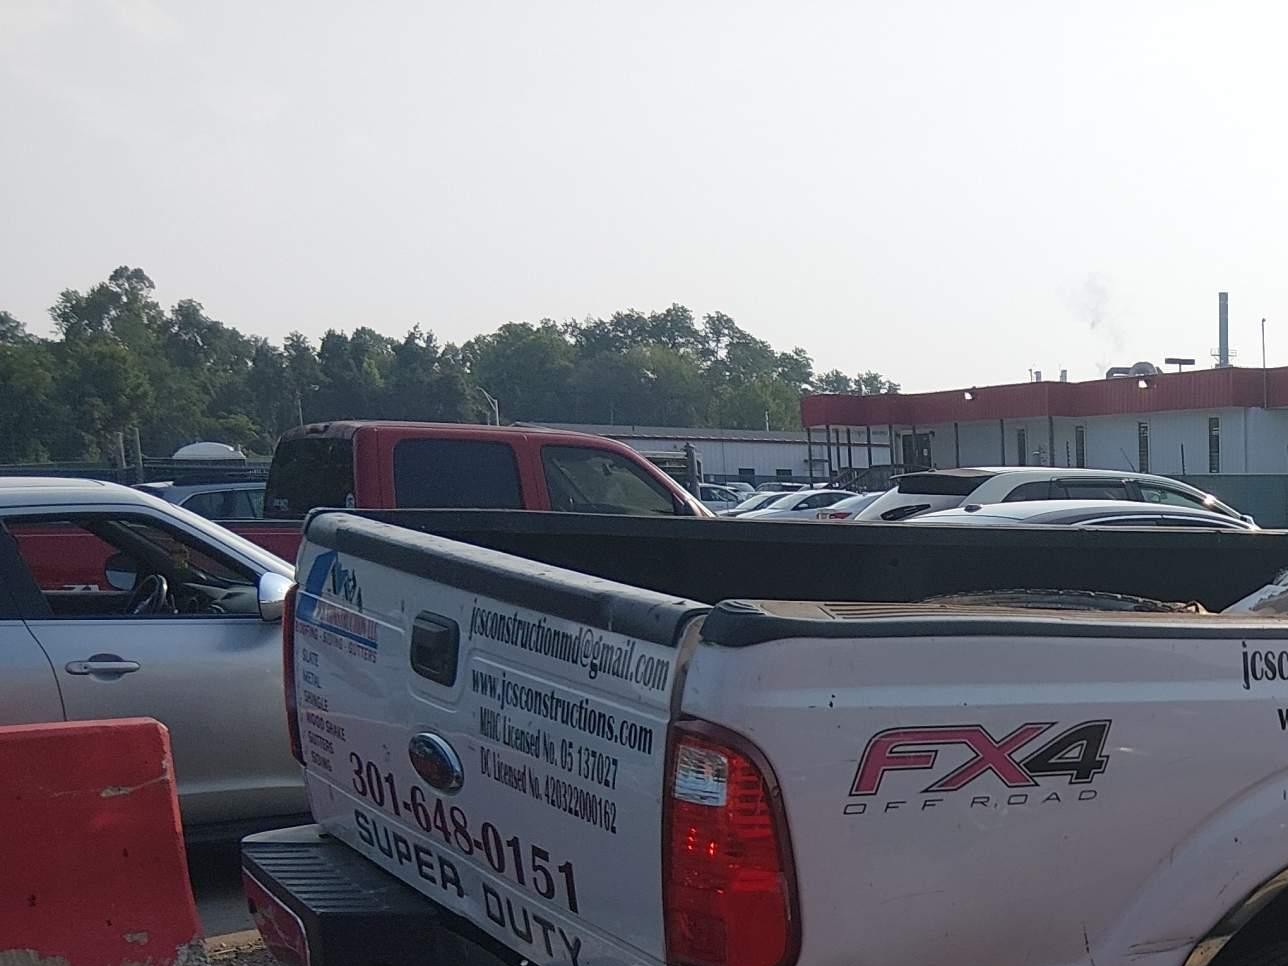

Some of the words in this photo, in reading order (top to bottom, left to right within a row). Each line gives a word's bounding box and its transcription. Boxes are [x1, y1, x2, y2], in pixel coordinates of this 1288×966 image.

[469, 598, 670, 691] jcsconstructionmd@gmail.com
[472, 669, 653, 755] www.jcsconstructions.com
[480, 706, 500, 741] MHIC
[503, 716, 540, 759] Licensed
[543, 731, 557, 766] No.
[561, 738, 573, 773] 05
[577, 745, 618, 790] 137027
[480, 746, 491, 778] DC
[493, 752, 526, 794] Licensed
[528, 767, 542, 801] No.
[544, 775, 617, 834] 420322000162
[849, 719, 1112, 797] FX4
[350, 752, 579, 914] 301-648-0151
[843, 798, 944, 815] OFF
[970, 790, 1098, 808] ROAD
[354, 809, 465, 898] SUPER
